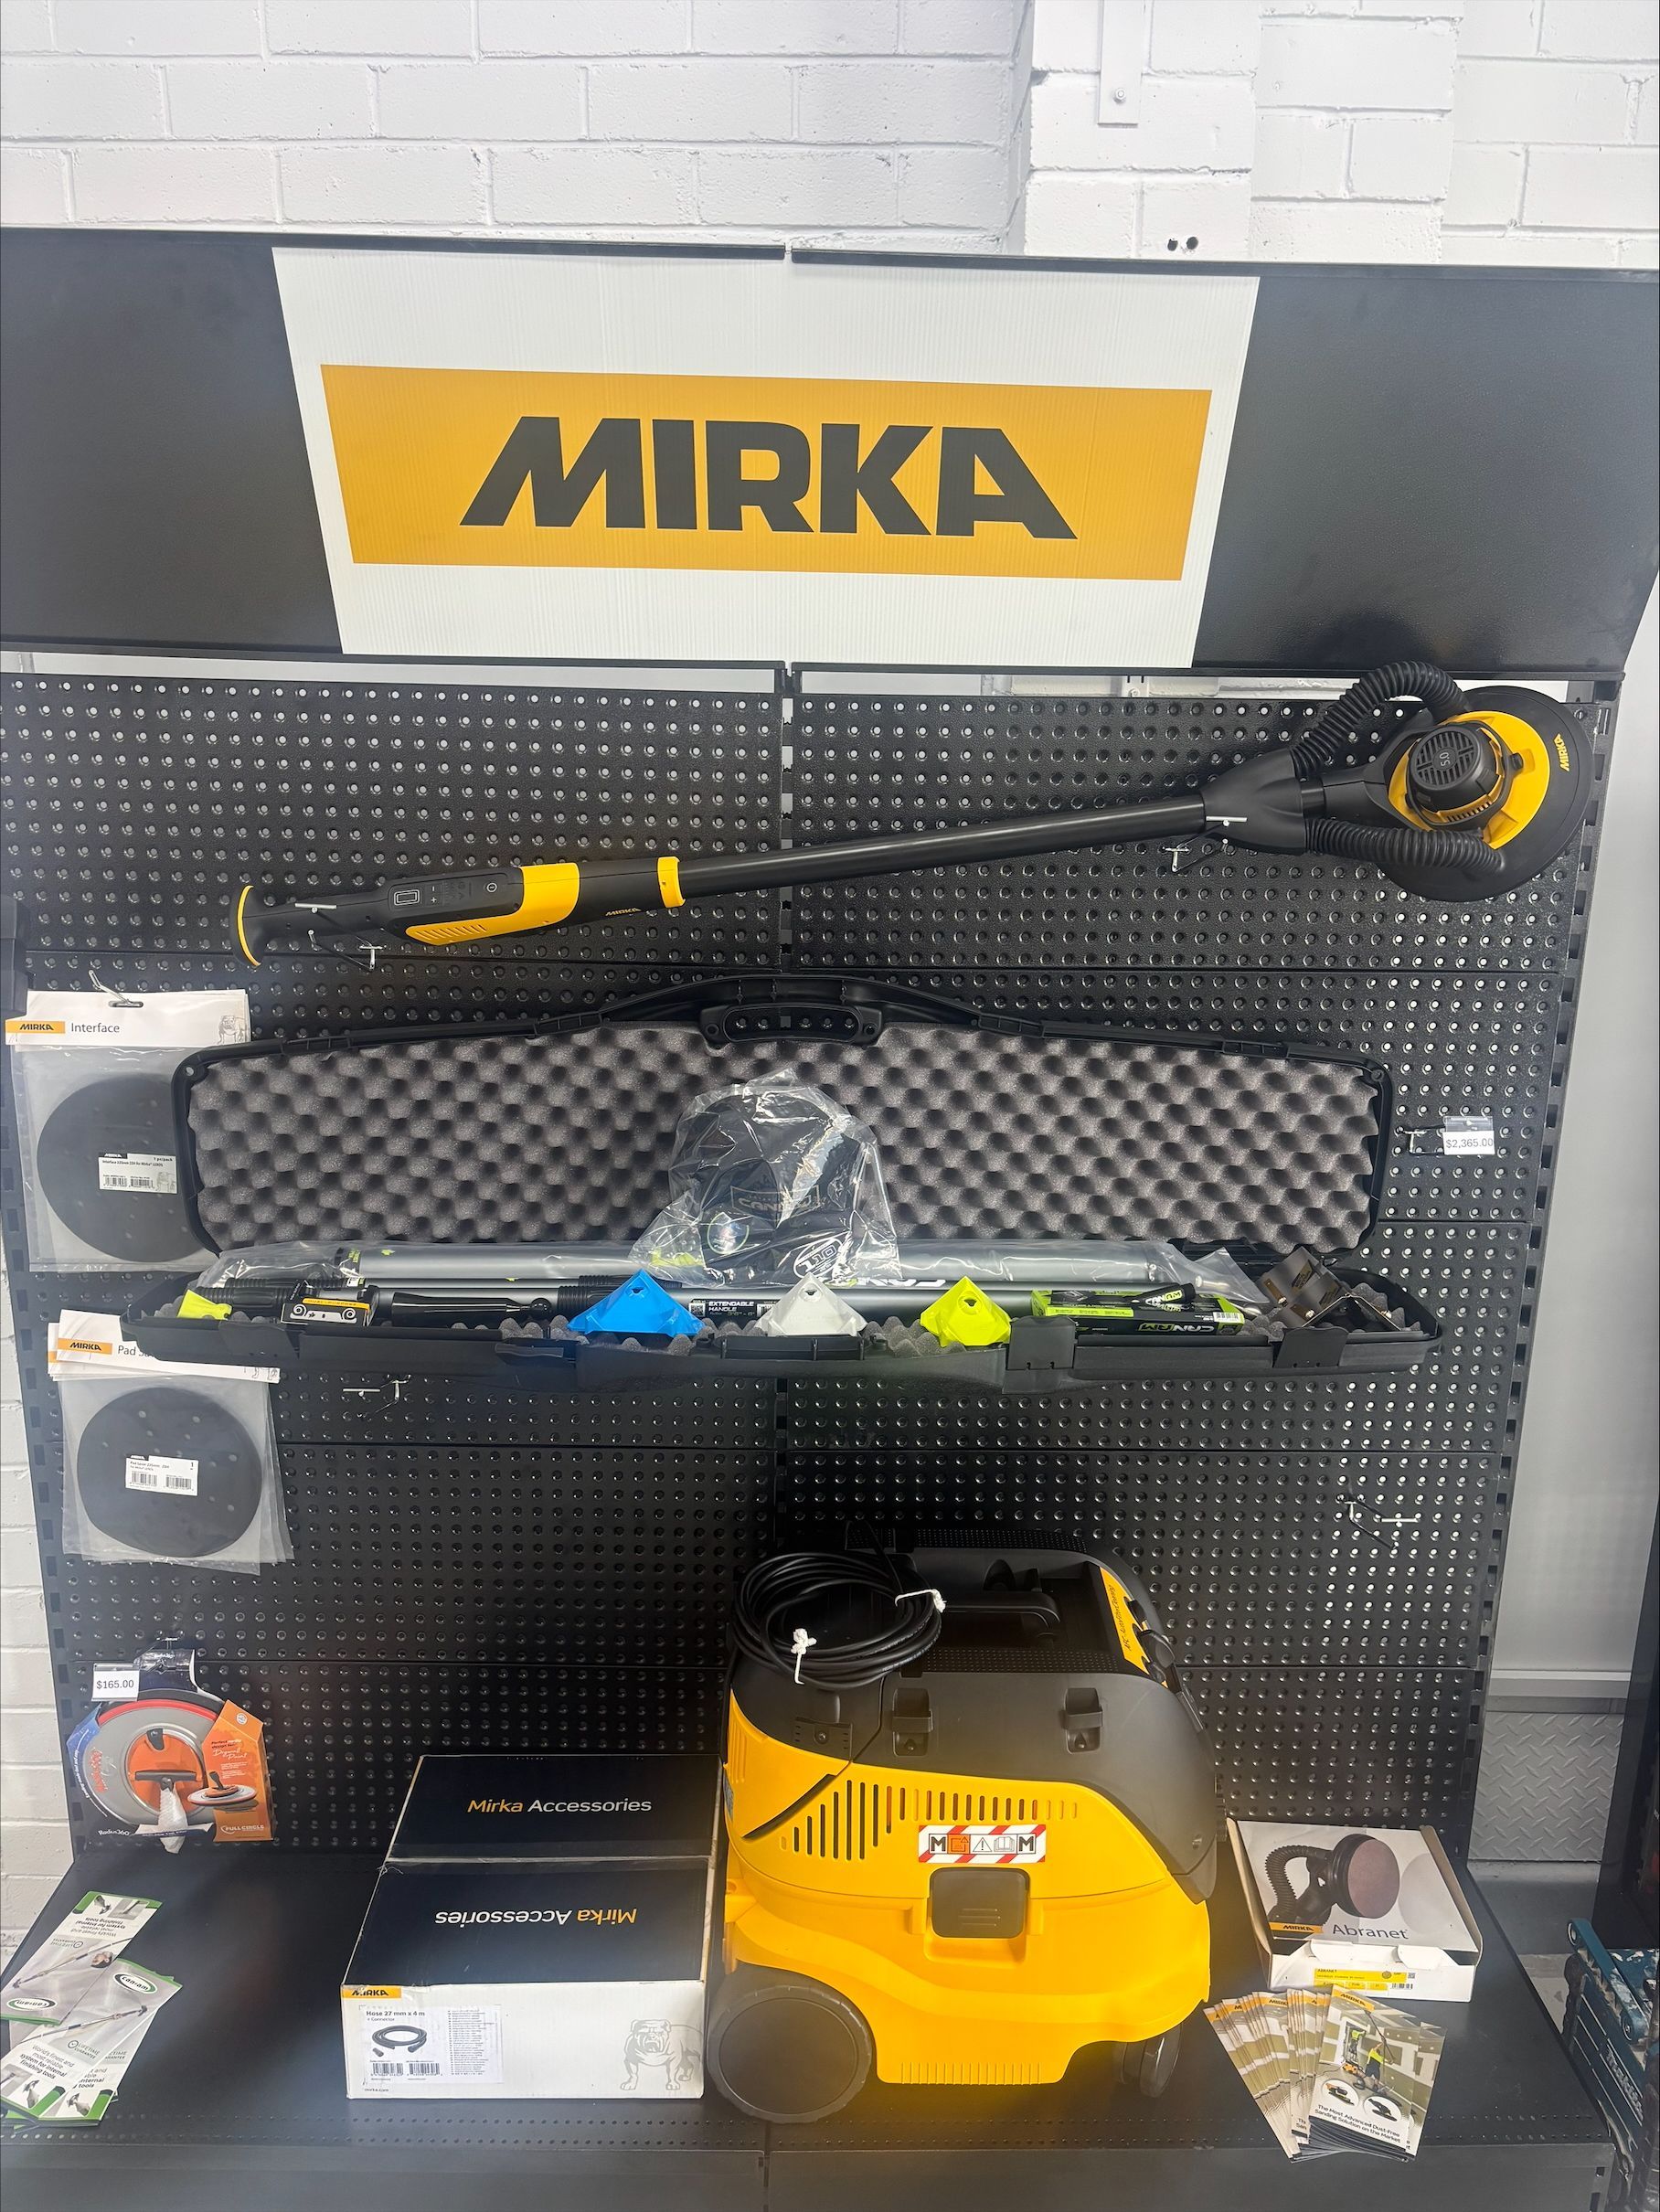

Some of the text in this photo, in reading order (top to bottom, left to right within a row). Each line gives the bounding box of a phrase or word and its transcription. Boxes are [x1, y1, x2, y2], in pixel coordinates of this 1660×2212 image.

[459, 416, 1079, 539] MIRKA
[1554, 733, 1570, 771] MIRKA
[19, 1022, 120, 1033] MIRKA Interface
[1445, 1137, 1494, 1149] $2,365.00
[69, 1341, 101, 1351] MIRKA
[118, 1345, 136, 1356] Pad
[96, 1679, 134, 1690] $165.00
[467, 1798, 652, 1813] Mirka Accessories
[931, 1835, 1034, 1852] M M
[435, 1908, 637, 1928] Mirka Accessories
[1282, 1924, 1314, 1932] MIRKA
[32, 2045, 50, 2057] World's
[63, 2058, 75, 2068] and
[78, 2042, 101, 2056] LIFETIME
[20, 2053, 67, 2077] system for internal
[20, 2059, 56, 2079] finishing tools
[1314, 2109, 1337, 2121] Sanding
[1338, 2116, 1361, 2130] Solution
[1369, 2128, 1380, 2136] the
[1380, 2132, 1401, 2143] Market
[1329, 2108, 1344, 2117] Most
[1344, 2114, 1372, 2128] Advanced
[1372, 2123, 1400, 2137] Dust-Free
